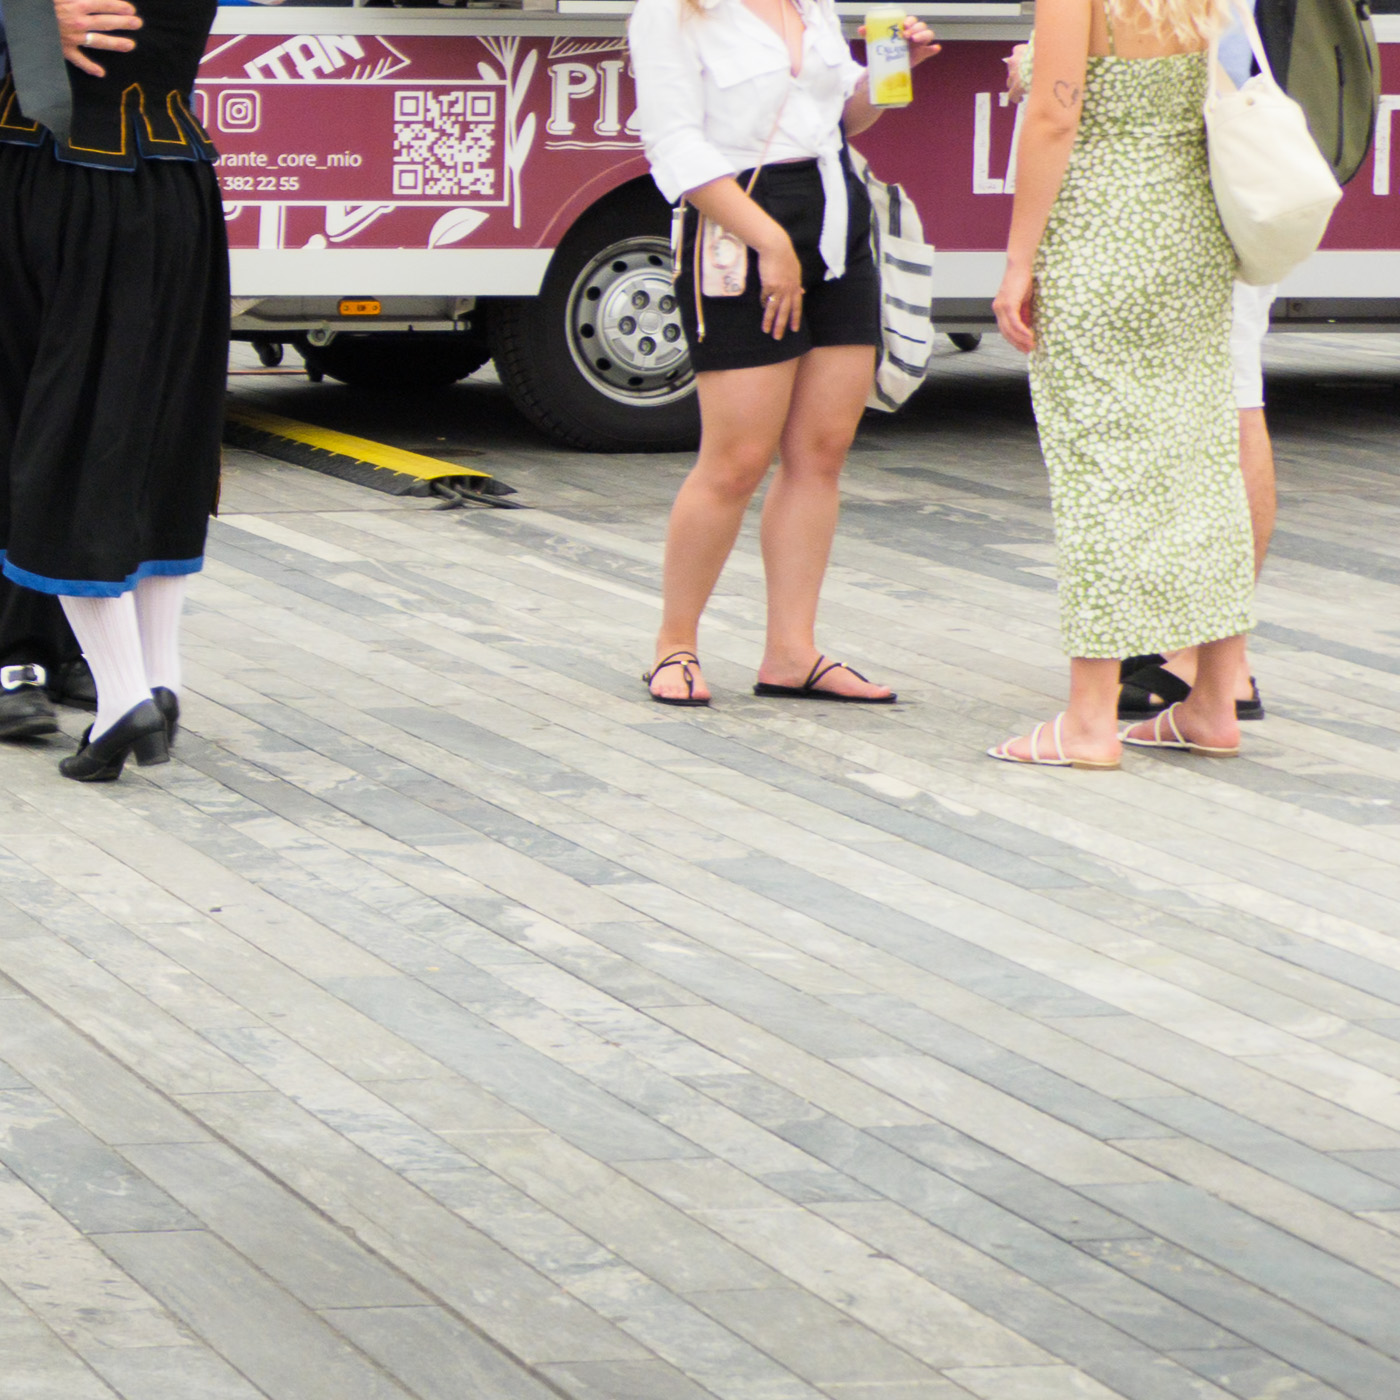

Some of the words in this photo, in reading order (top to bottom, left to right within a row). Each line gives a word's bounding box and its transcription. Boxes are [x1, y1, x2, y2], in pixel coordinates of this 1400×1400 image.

[222, 177, 254, 190] 382
[256, 177, 279, 190] 22
[280, 177, 299, 190] 55
